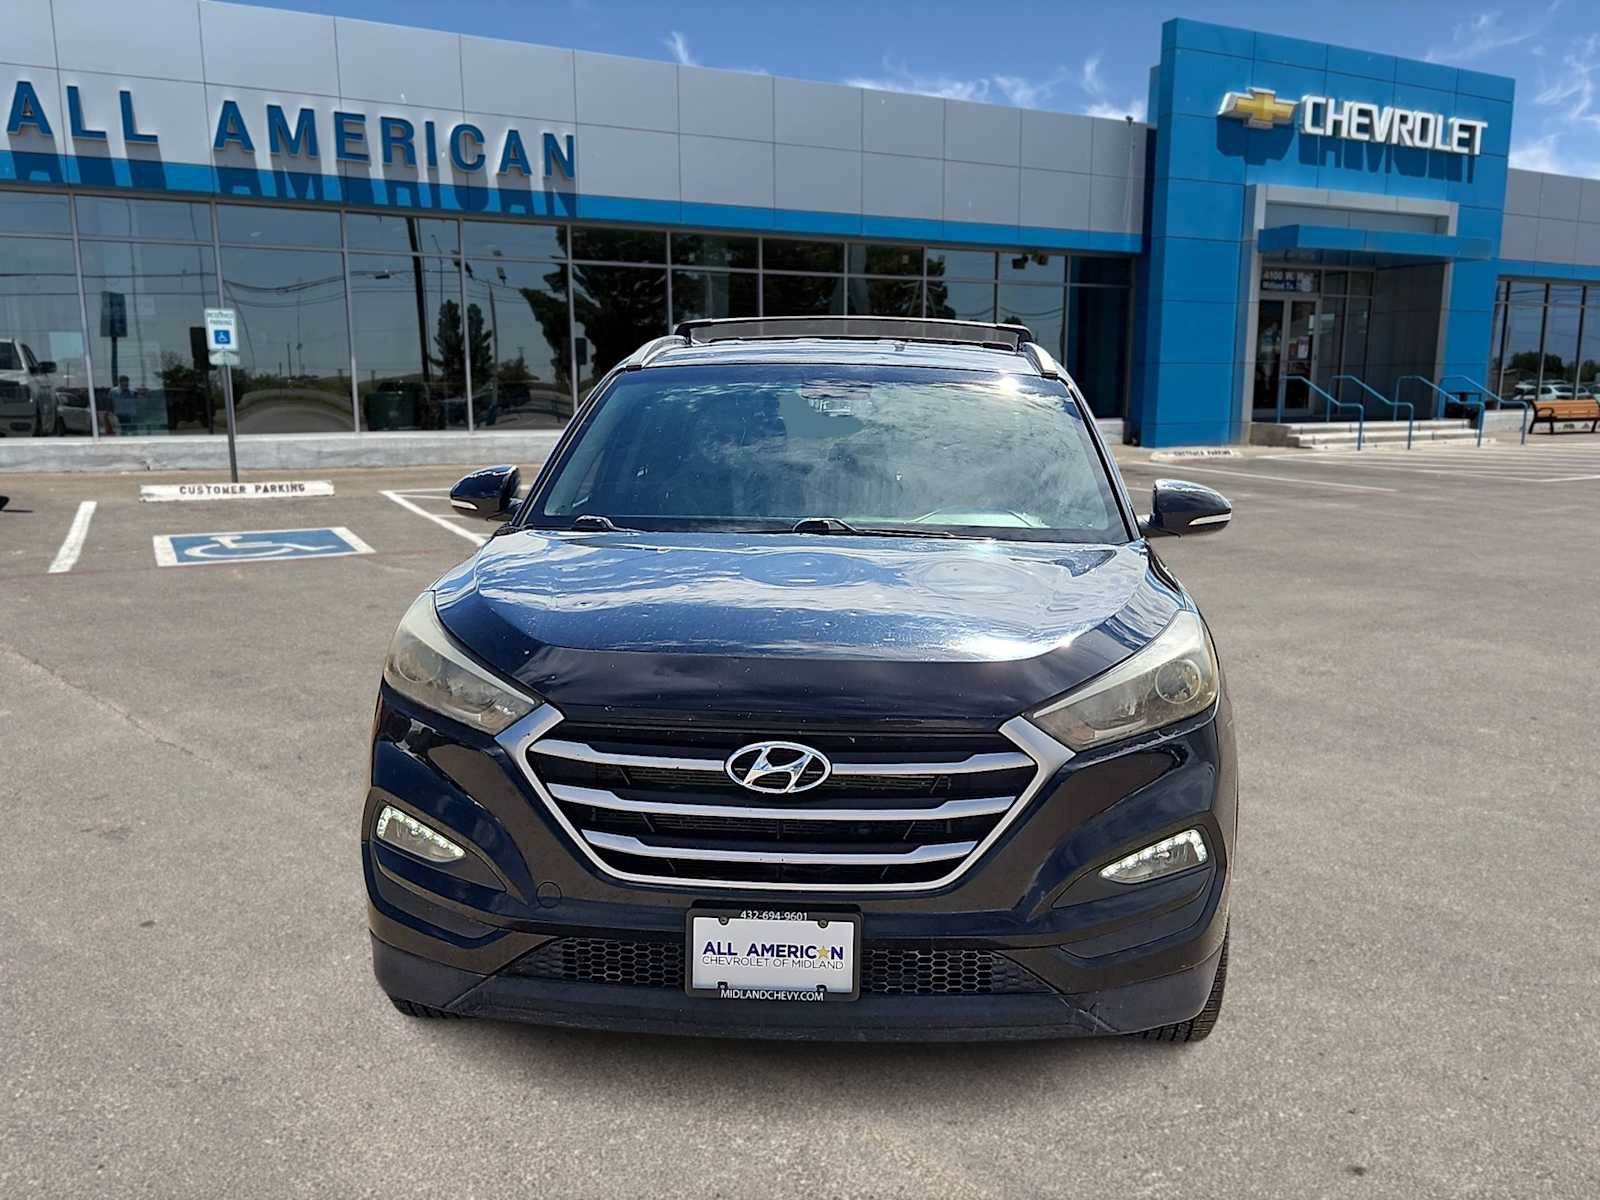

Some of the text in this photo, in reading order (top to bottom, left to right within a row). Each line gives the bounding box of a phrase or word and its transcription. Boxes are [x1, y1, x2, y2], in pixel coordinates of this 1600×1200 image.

[6, 80, 576, 178] ALL AMERICAN
[1301, 94, 1488, 155] CHEVROLET
[179, 483, 305, 495] CUSTOMER PARKING
[740, 910, 807, 921] 432-694-9601
[703, 941, 844, 960] ALL AMERICN
[702, 956, 844, 970] CHEVROLET OF MIDLAND
[720, 989, 824, 1001] MIDLANDCHEVY.COM
